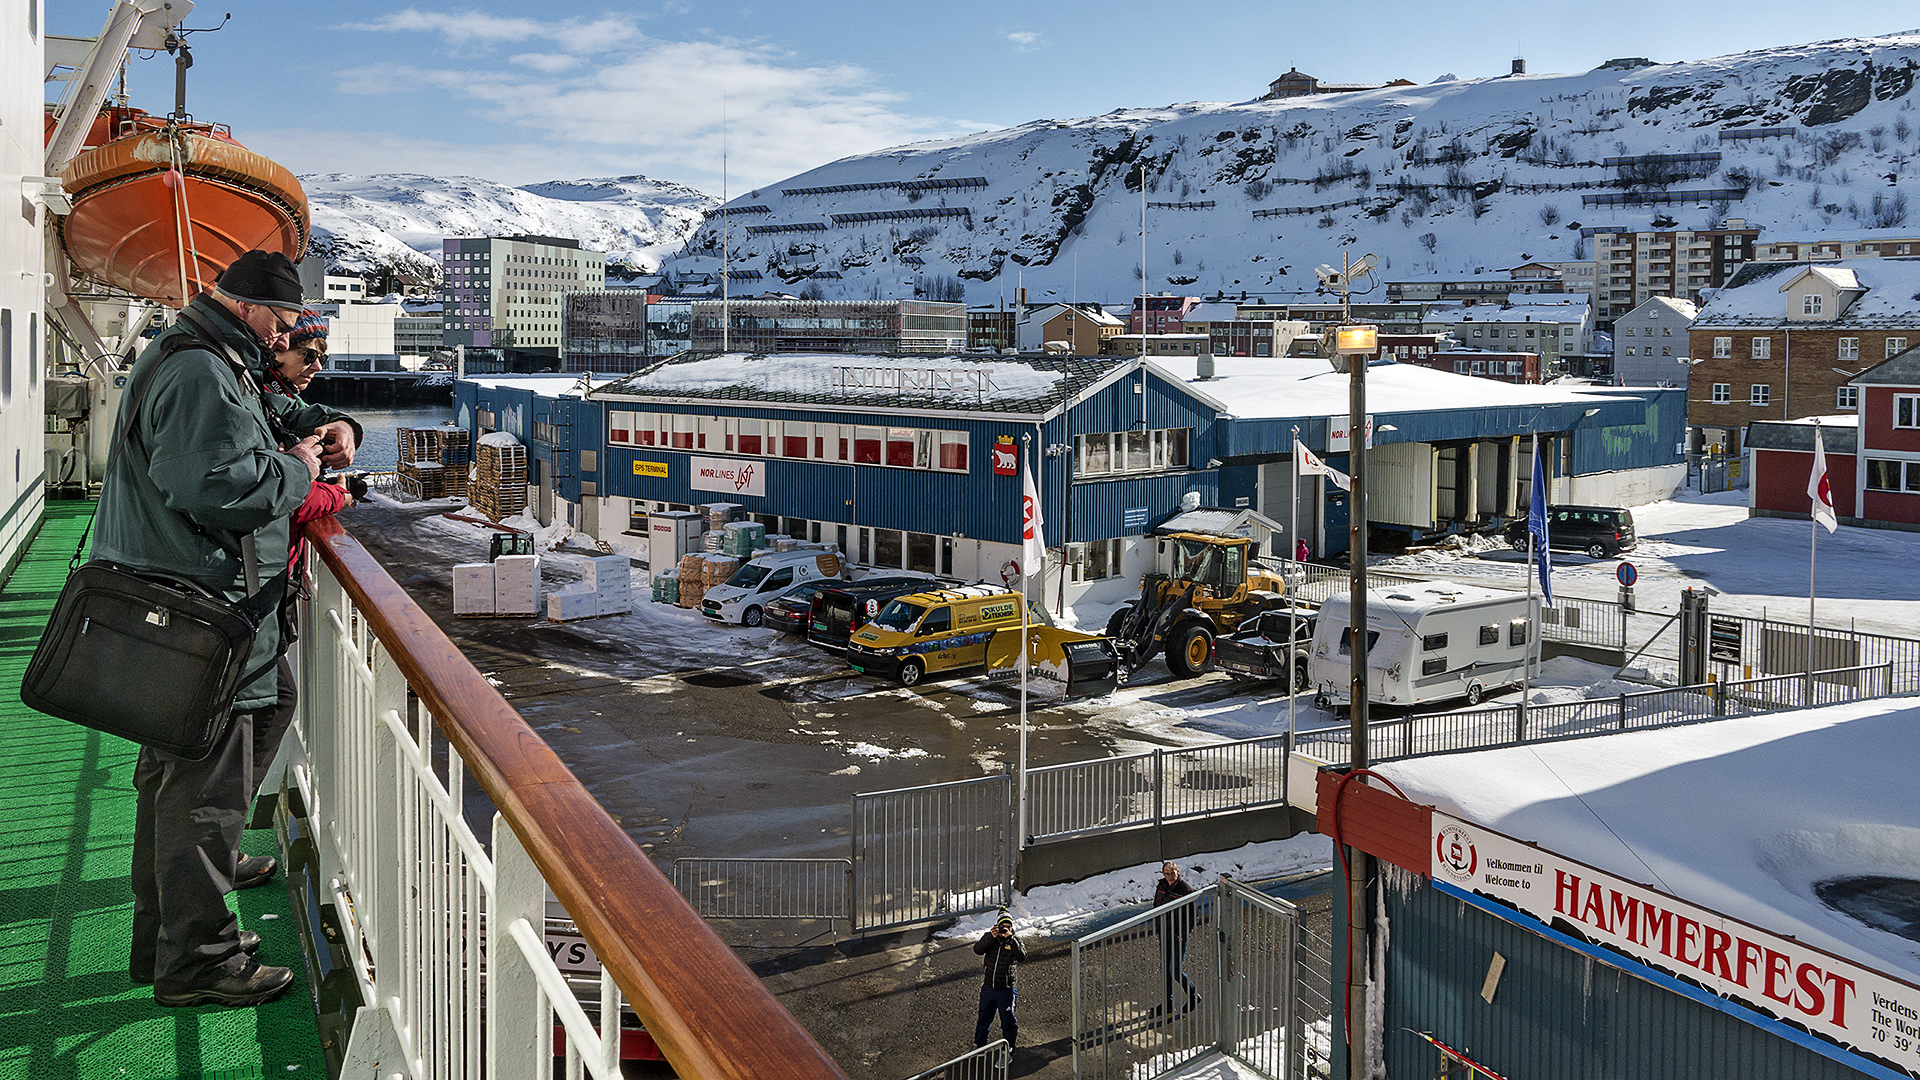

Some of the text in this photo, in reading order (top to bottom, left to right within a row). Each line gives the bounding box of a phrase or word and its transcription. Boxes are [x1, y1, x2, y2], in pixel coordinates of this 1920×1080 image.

[830, 366, 994, 392] HAMMERFEST
[645, 465, 667, 474] TERMINAL
[700, 468, 735, 480] NOR LINES
[990, 604, 1014, 612] KULDE
[1486, 858, 1543, 875] Velkommen til
[1485, 874, 1531, 889] Welcome to
[1553, 868, 1857, 1030] HAMMERFEST
[1872, 991, 1918, 1020] Verdens
[1871, 1008, 1892, 1028] The
